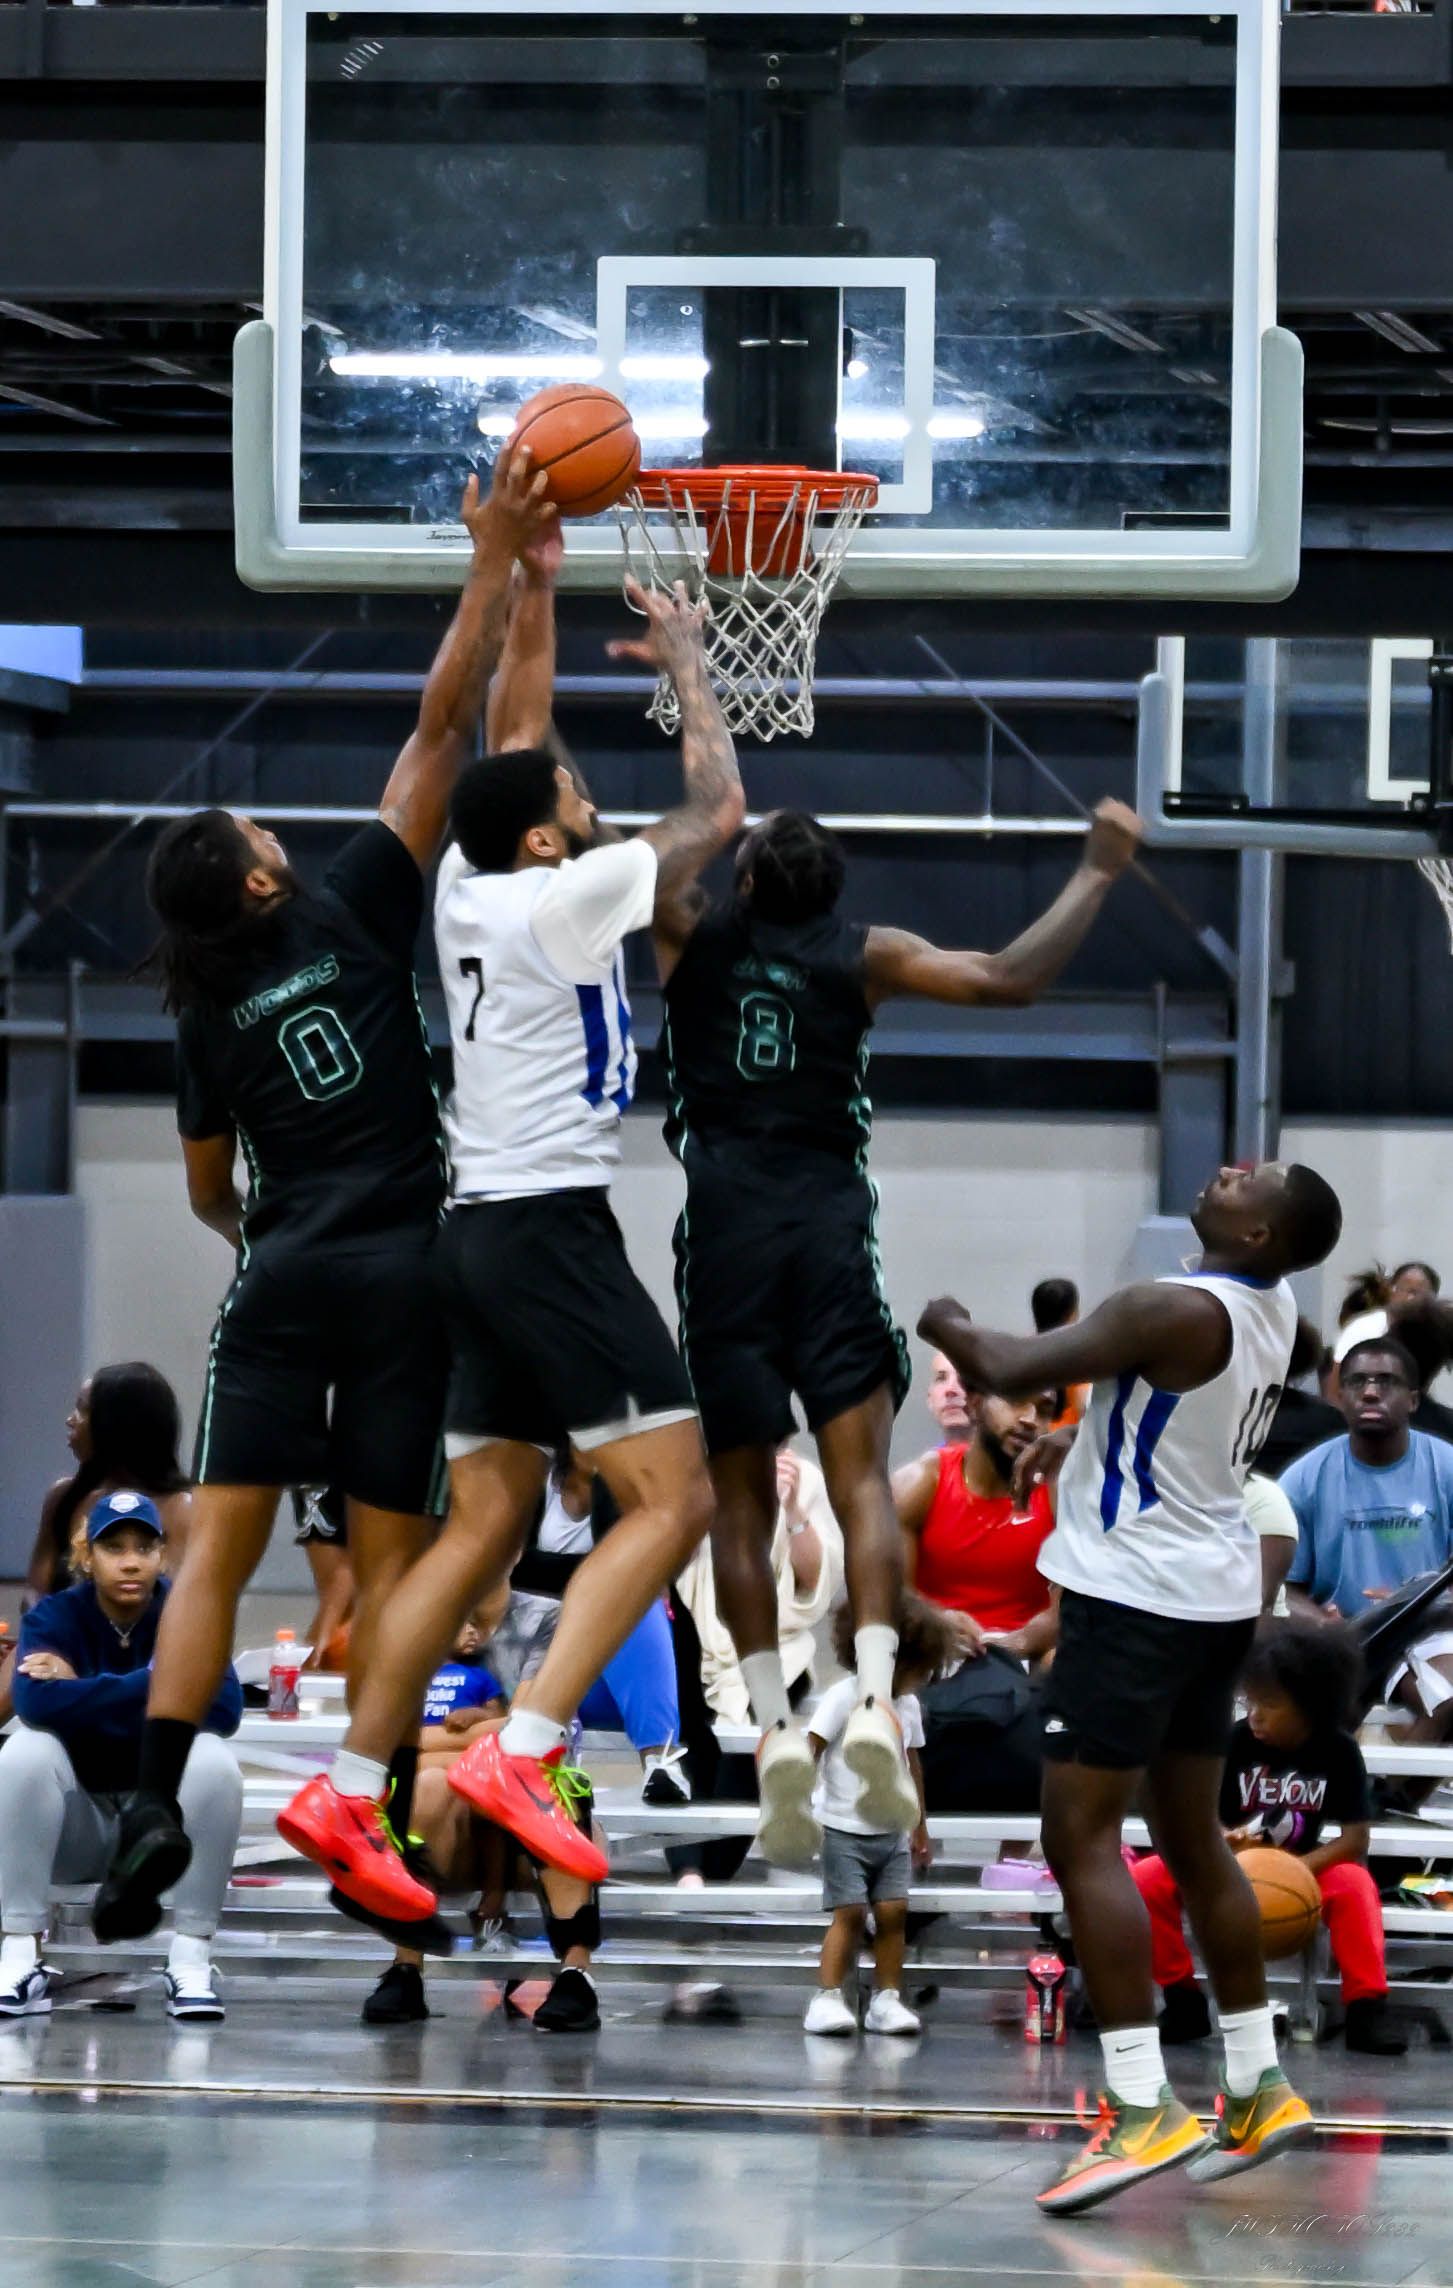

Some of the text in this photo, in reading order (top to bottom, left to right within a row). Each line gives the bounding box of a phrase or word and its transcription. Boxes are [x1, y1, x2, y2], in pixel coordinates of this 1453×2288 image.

[458, 957, 485, 1042] 7
[736, 991, 797, 1082] 8
[277, 1005, 364, 1102] 0
[1231, 1383, 1282, 1467] 10
[424, 1703, 450, 1717] Fan
